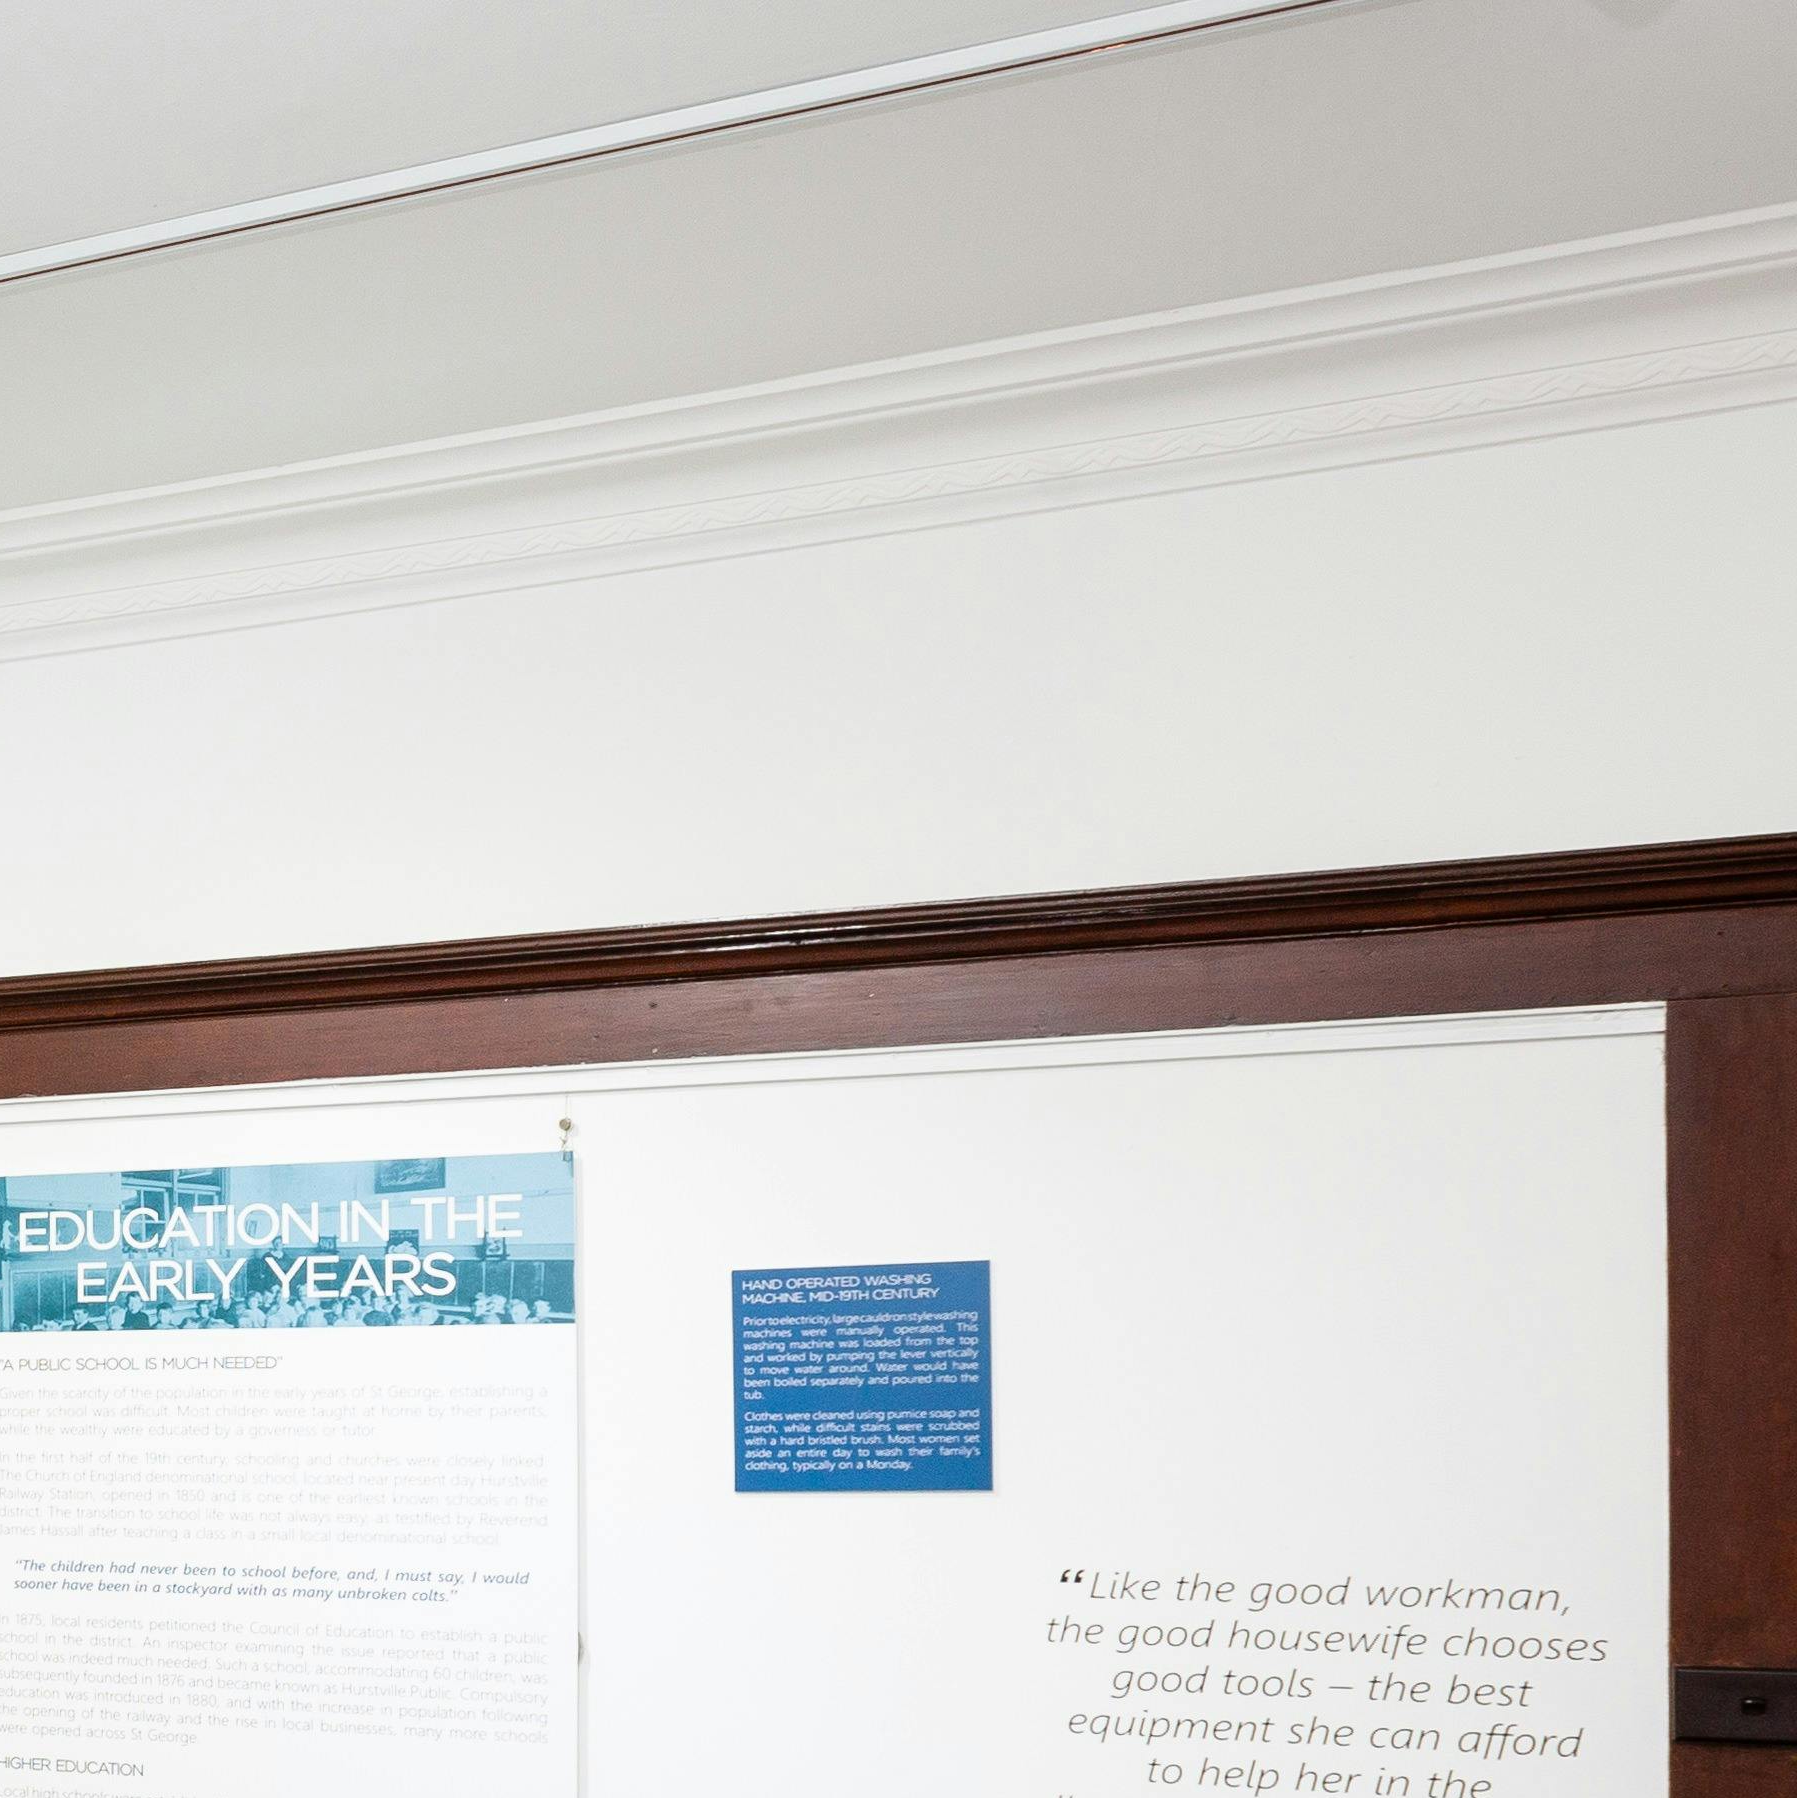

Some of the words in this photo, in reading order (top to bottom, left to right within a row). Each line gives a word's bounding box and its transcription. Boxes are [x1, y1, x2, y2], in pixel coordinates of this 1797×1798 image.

[17, 1201, 319, 1254] EDUCATION
[340, 1198, 389, 1244] IN
[410, 1192, 524, 1241] THE
[76, 1258, 246, 1303] EARLY
[266, 1251, 457, 1300] YEARS
[743, 1280, 782, 1289] HAND
[786, 1277, 859, 1289] OPERATED
[865, 1274, 931, 1285] WASHING
[743, 1292, 806, 1303] MACHINE,
[810, 1290, 869, 1301] MID-19TH
[873, 1288, 939, 1300] CENTURY
[19, 1358, 70, 1371] PUBLIC
[76, 1358, 139, 1370] SCHOOL
[146, 1358, 157, 1369] IS
[163, 1357, 208, 1369] MUCH
[1177, 1573, 1235, 1602] the
[1251, 1576, 1351, 1609] good
[1367, 1579, 1569, 1616] workman,
[1048, 1616, 1103, 1644] the
[1117, 1620, 1214, 1653] good
[1229, 1621, 1427, 1660] housewife
[1444, 1627, 1608, 1661] chooses
[1111, 1667, 1209, 1698] good
[1224, 1669, 1314, 1698] tools
[1369, 1672, 1430, 1702] the
[1448, 1675, 1533, 1707] best
[1069, 1711, 1274, 1745] equipment
[1288, 1716, 1354, 1746] she
[1370, 1728, 1440, 1750] can
[1458, 1723, 1584, 1759] afford
[56, 1759, 143, 1776] EDUCATION
[1149, 1759, 1182, 1784] to
[1198, 1758, 1279, 1792] help
[1296, 1763, 1361, 1793] her
[1375, 1768, 1409, 1796] in
